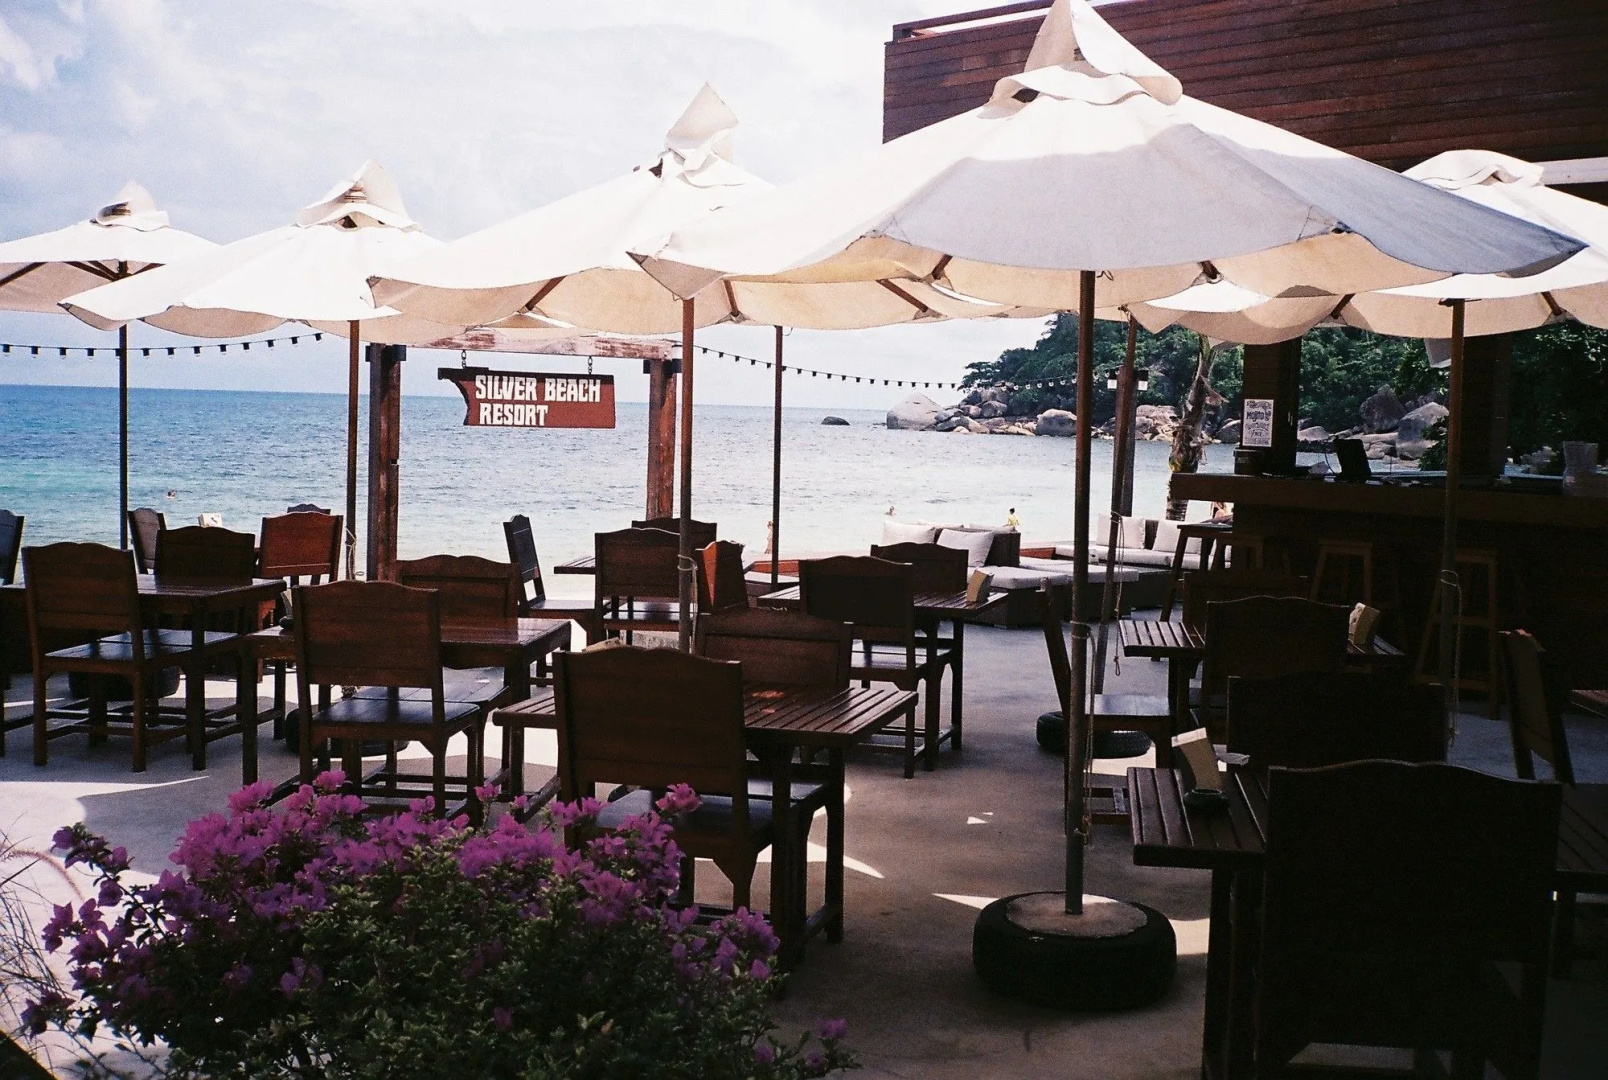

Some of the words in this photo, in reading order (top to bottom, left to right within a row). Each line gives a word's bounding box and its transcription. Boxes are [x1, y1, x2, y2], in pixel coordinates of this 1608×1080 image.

[475, 375, 538, 401] SILVER
[544, 378, 601, 402] BEACH
[480, 403, 549, 426] RESORT
